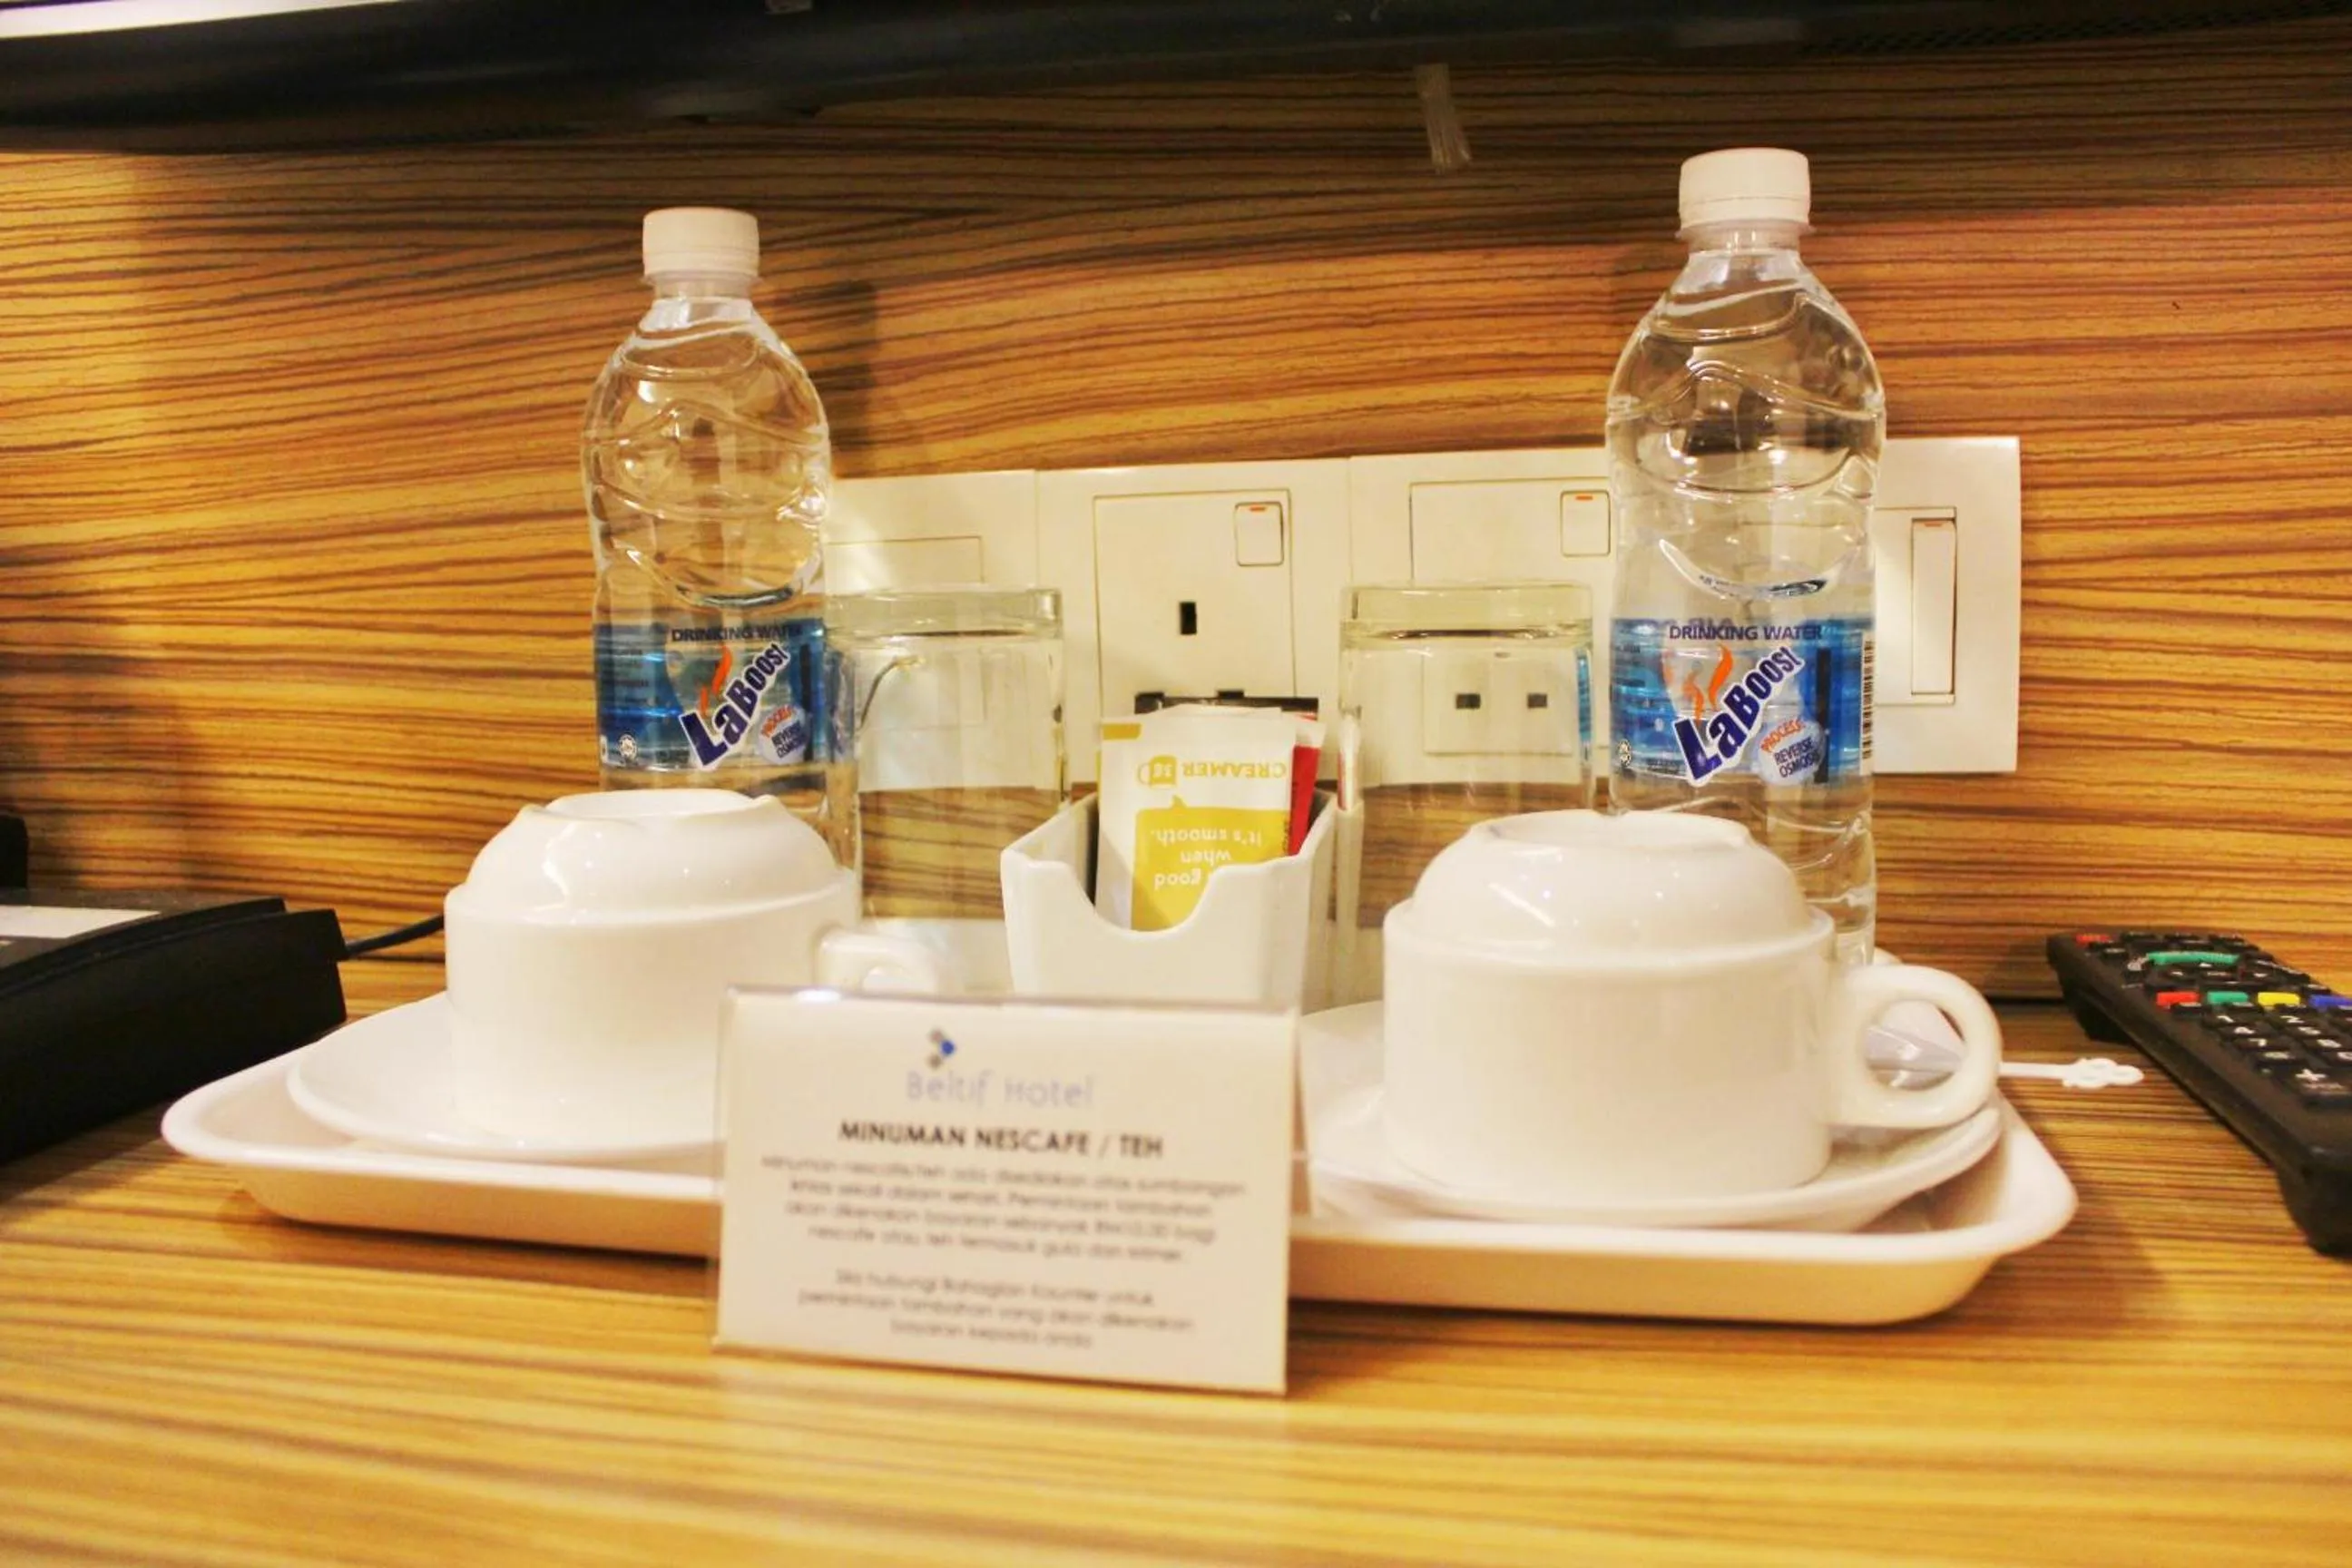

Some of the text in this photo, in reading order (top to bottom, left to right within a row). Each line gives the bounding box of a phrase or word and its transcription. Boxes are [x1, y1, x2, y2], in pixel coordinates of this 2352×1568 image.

[1670, 624, 1822, 641] DRINKING WATER
[1183, 762, 1287, 779] CREAMER
[1181, 851, 1231, 867] when
[1154, 868, 1202, 889] good
[1004, 1073, 1094, 1108] Hotel
[838, 1121, 965, 1149] MINUMAN
[975, 1126, 1091, 1156] NESCAFE
[1120, 1132, 1164, 1159] TEH
